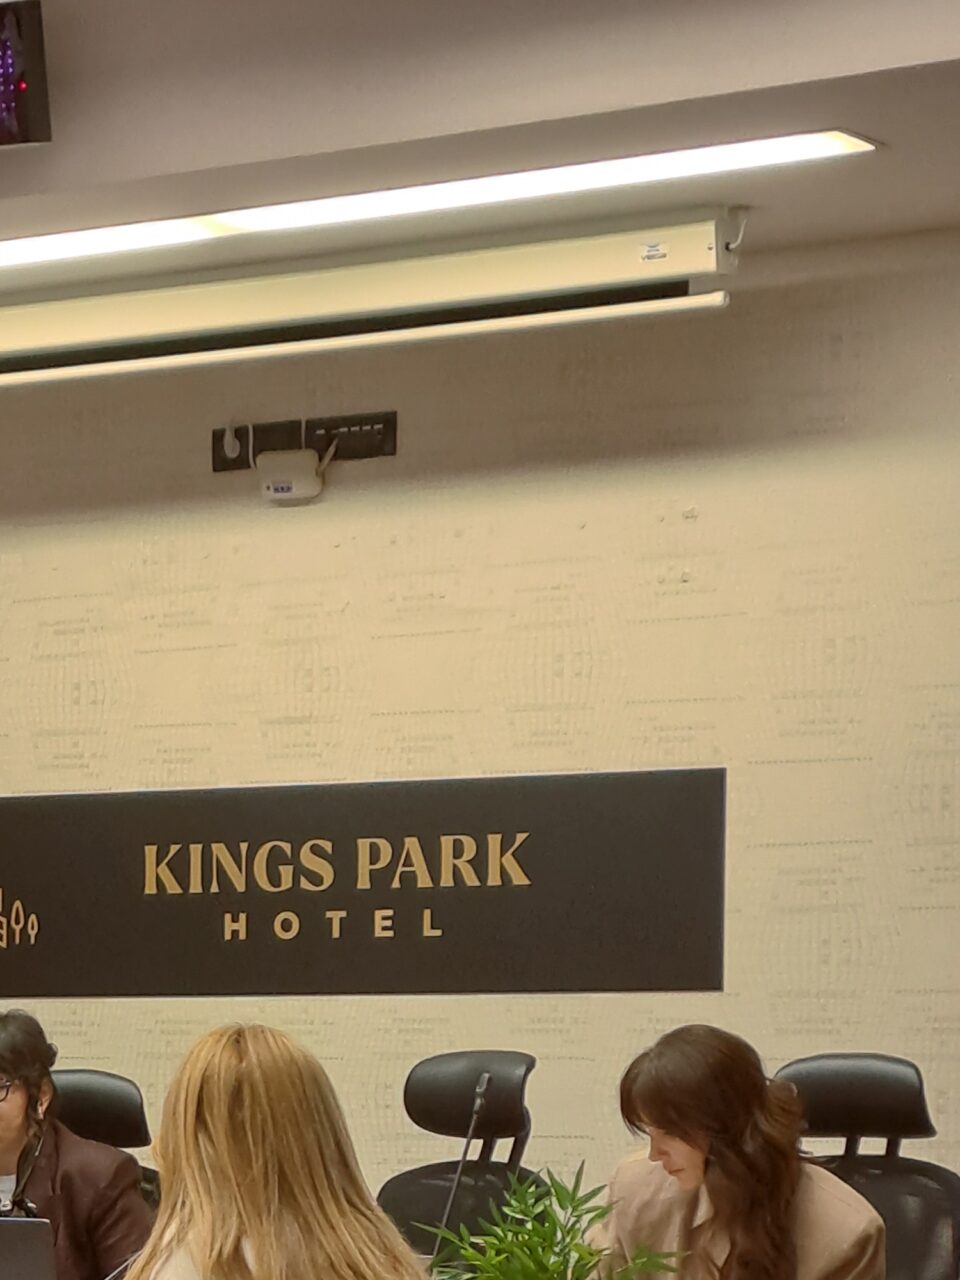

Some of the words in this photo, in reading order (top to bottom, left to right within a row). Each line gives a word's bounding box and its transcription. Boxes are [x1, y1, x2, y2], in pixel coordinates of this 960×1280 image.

[144, 838, 335, 896] KINGS
[356, 832, 532, 889] PARK
[224, 908, 442, 941] HOTEL
